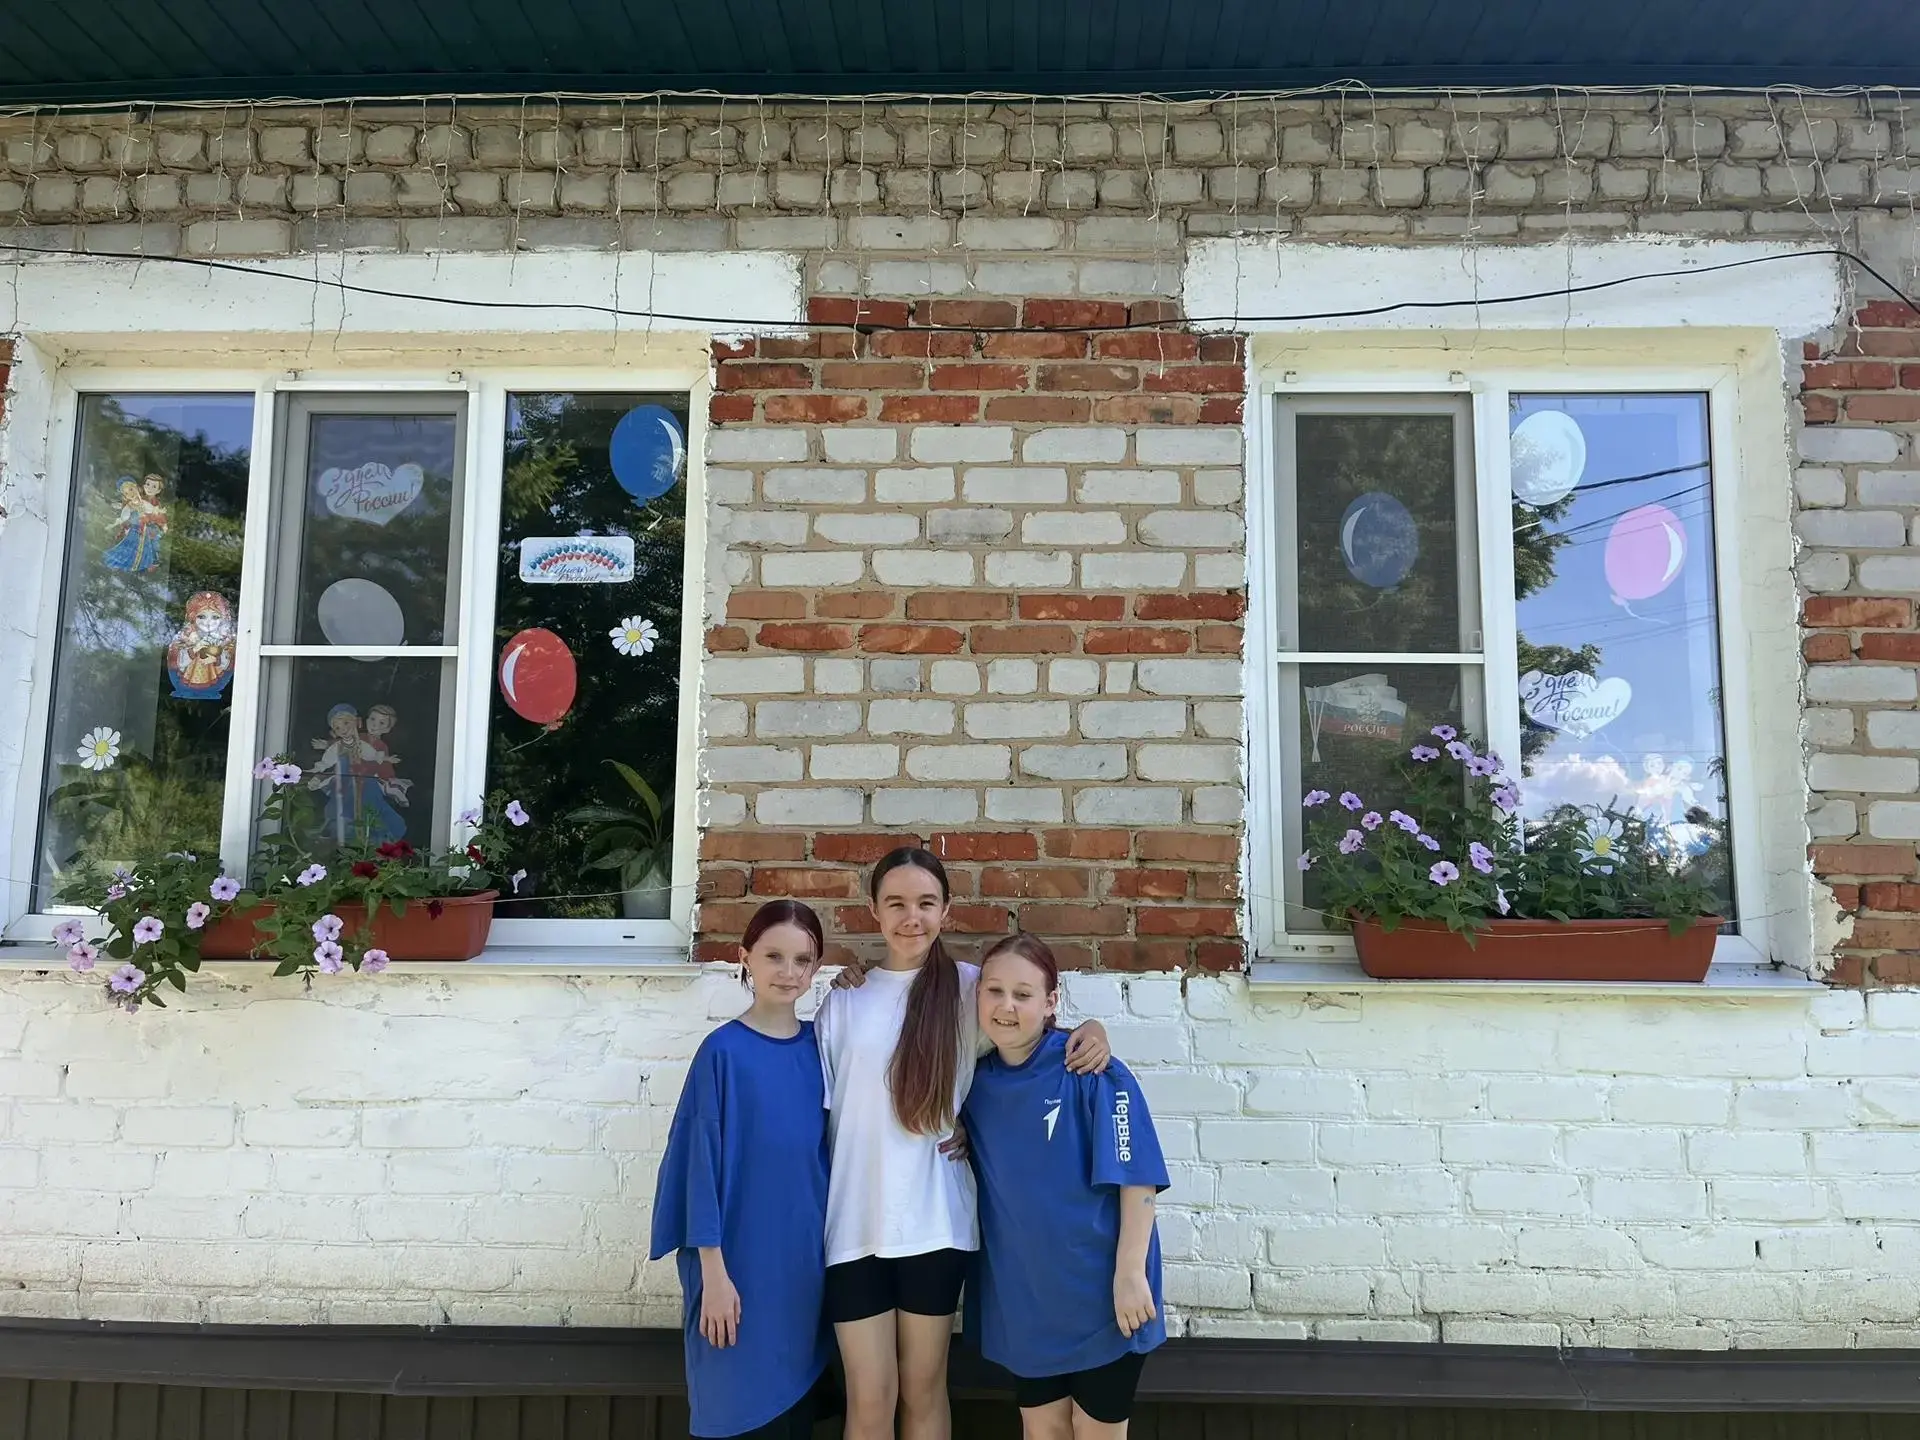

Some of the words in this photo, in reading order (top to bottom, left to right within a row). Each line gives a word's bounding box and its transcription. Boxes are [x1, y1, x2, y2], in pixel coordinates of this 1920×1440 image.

[352, 482, 415, 514] России!
[1551, 698, 1620, 723] России!
[1111, 1091, 1132, 1162] Первые
